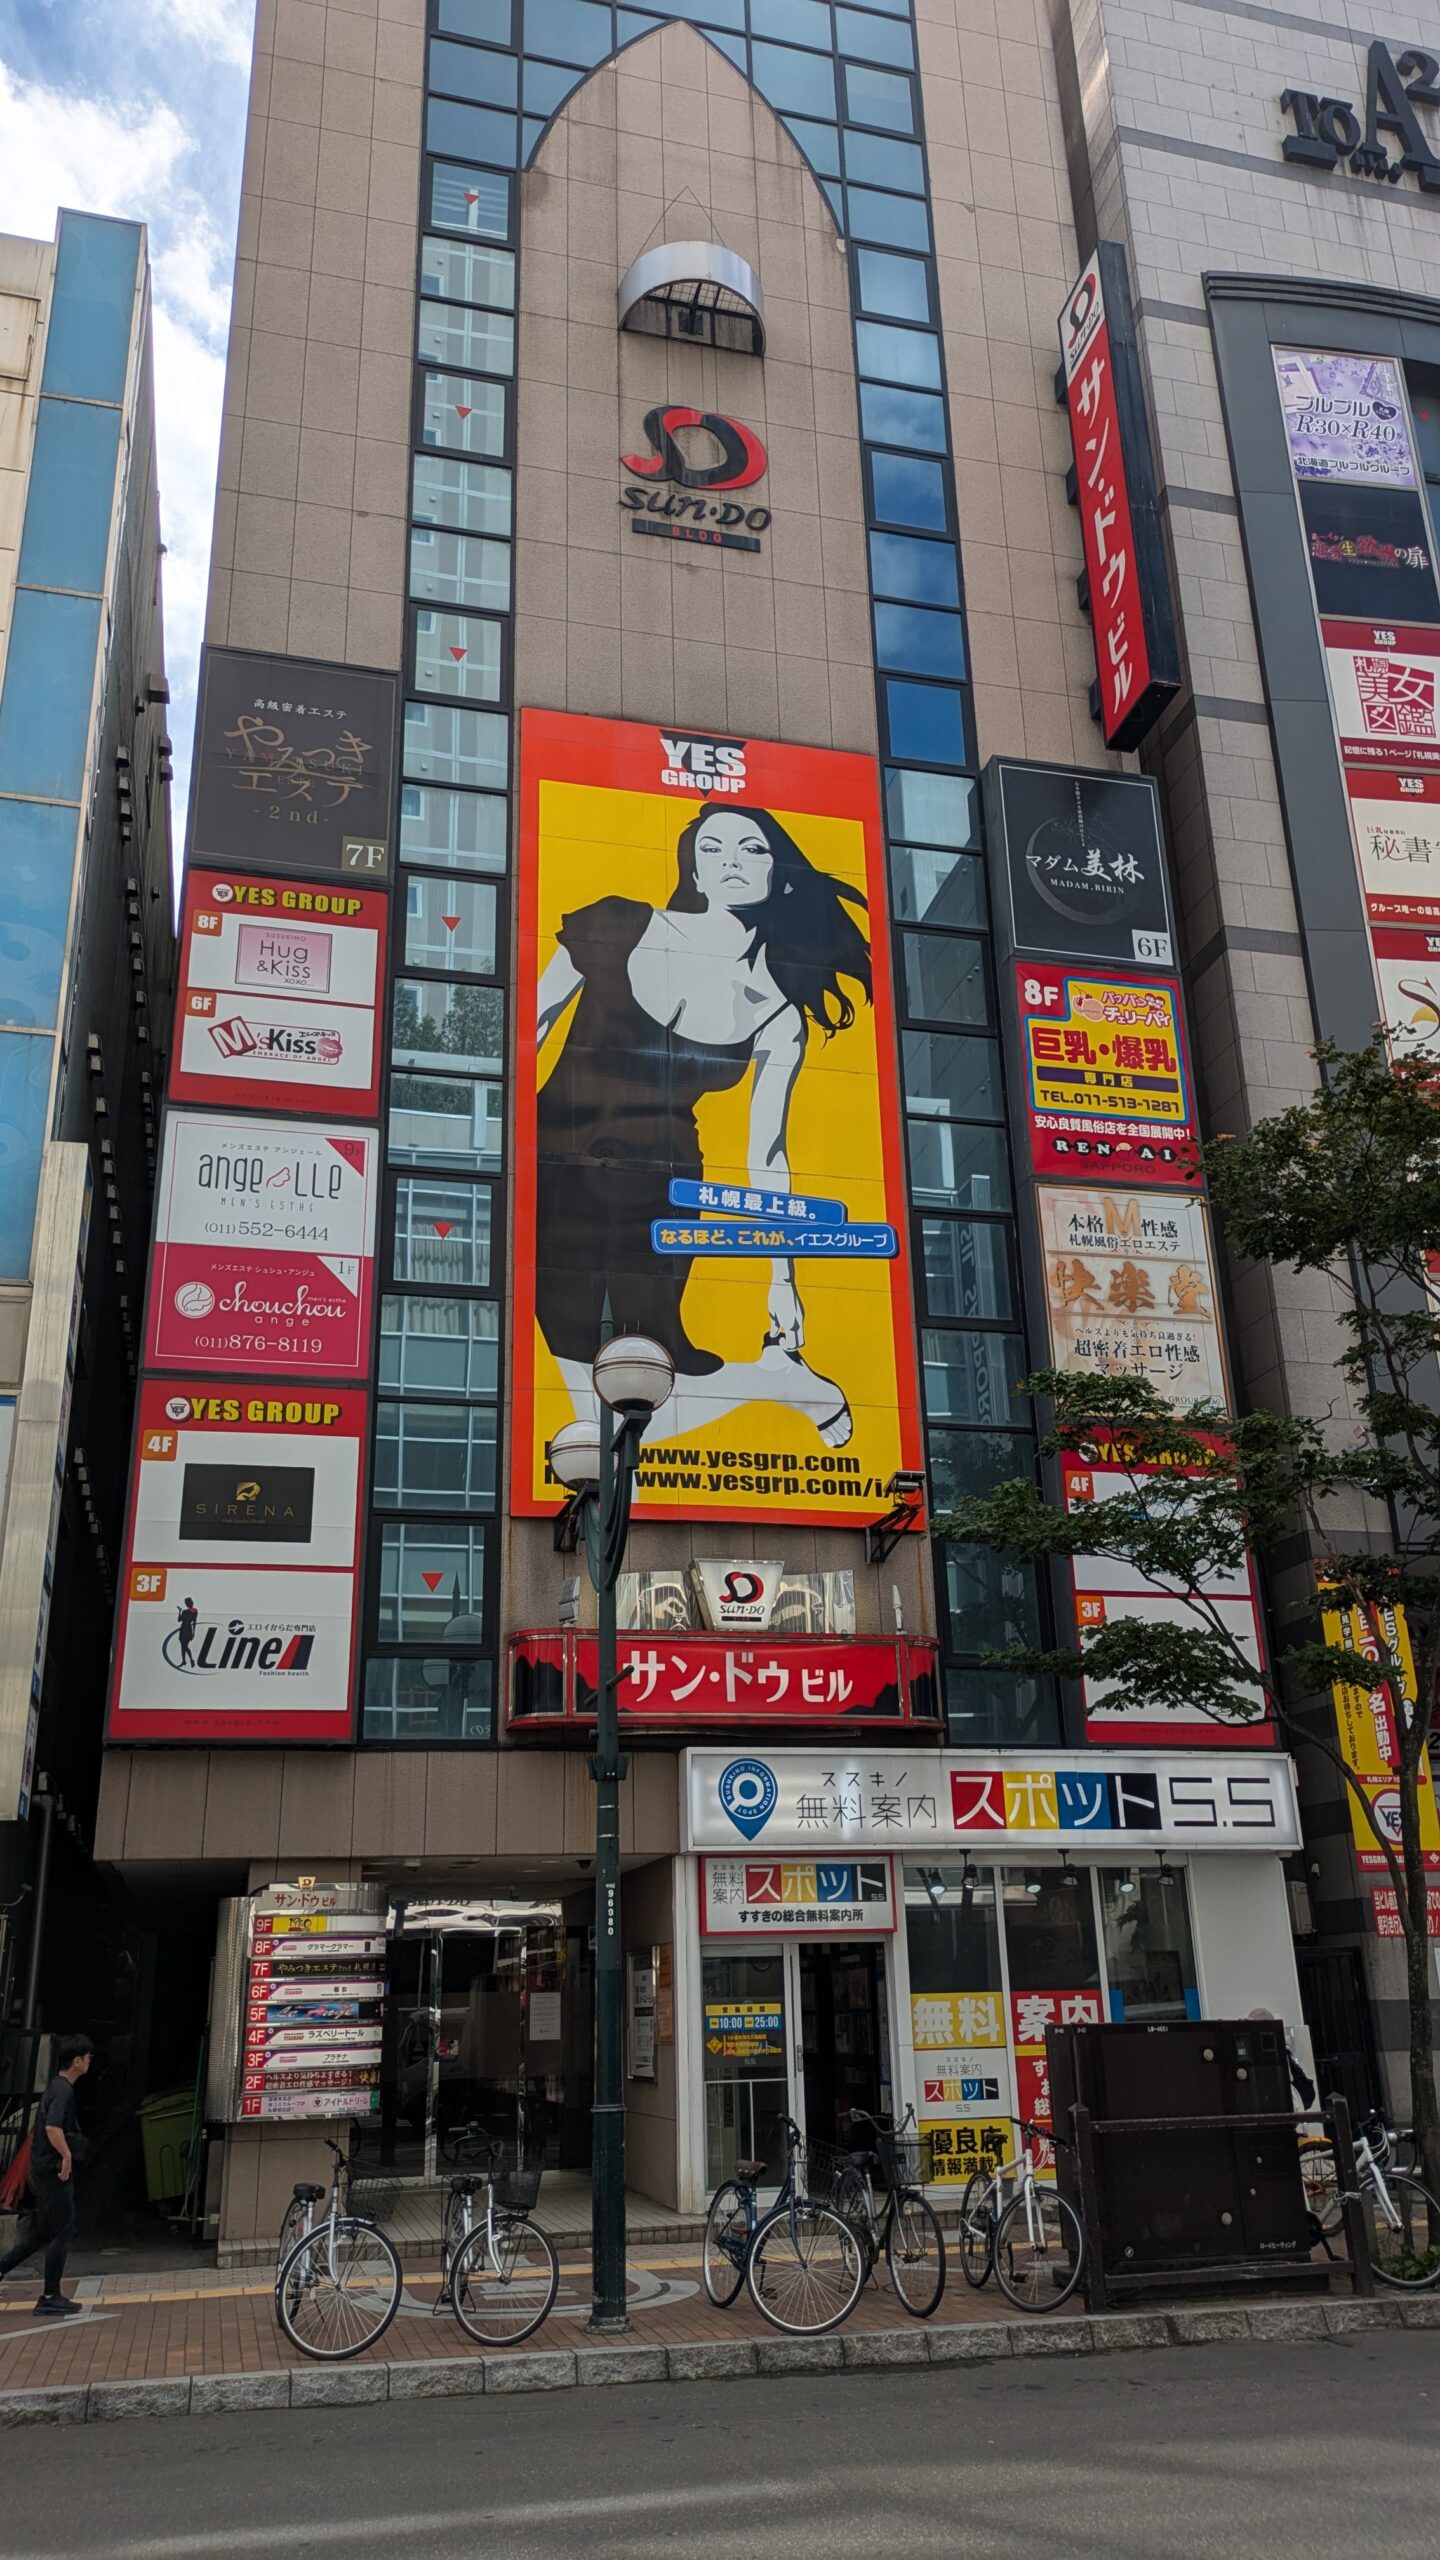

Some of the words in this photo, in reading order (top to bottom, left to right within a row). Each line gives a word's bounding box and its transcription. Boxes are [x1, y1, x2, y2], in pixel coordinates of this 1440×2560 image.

[1295, 395, 1371, 418] プルプル
[672, 525, 723, 544] BLDG
[1373, 629, 1396, 642] YES
[1374, 638, 1397, 647] GROUP
[1356, 666, 1435, 712] 美女
[253, 698, 348, 720] 高級密着エステ
[1362, 700, 1437, 738] 図鑑
[659, 737, 748, 778] YES
[231, 769, 364, 808] エステ
[660, 768, 747, 795] GROUP
[1398, 777, 1424, 789] YES
[1400, 786, 1424, 794] GROUP
[345, 843, 385, 868] 7F
[1025, 847, 1145, 884] マダム美林
[233, 885, 275, 906] YES
[281, 890, 362, 916] GROUP
[197, 914, 219, 930] 8F
[266, 932, 307, 941] SUSUKINO
[260, 939, 308, 963] Hug
[1137, 936, 1168, 958] 6F
[256, 959, 311, 979] &Kiss
[1024, 978, 1059, 1007] 8F
[191, 995, 213, 1011] 6F
[1103, 1006, 1171, 1027] チェリーパイ
[252, 1049, 289, 1058] EMBRACE
[1031, 1026, 1178, 1073] 巨乳・爆乳
[1084, 1071, 1133, 1088] 専門店
[1035, 1115, 1191, 1140] 安心良質風俗店を全国展開中!
[221, 1142, 270, 1152] メンズエステ
[274, 1146, 322, 1156] アンジェール
[1080, 1160, 1157, 1174] SAPPORO
[220, 1196, 260, 1209] MEN'S
[270, 1200, 314, 1212] ESTHE
[698, 1186, 817, 1220] 札幌最上級。
[660, 1229, 888, 1248] なるほど、これが、イエスグループ
[1069, 1234, 1181, 1254] 札幌風俗エロエステ
[210, 1263, 253, 1273] メンズエステ
[254, 1266, 316, 1277] シュシュ・アンジュ
[338, 1260, 356, 1275] 1F
[1051, 1258, 1212, 1320] 快楽堂
[219, 1281, 346, 1318] chouchou
[1074, 1338, 1201, 1363] 超密着エロ性感
[1094, 1361, 1183, 1380] マッサージ
[170, 1404, 186, 1414] YES
[191, 1398, 240, 1421] YES
[247, 1400, 341, 1425] GROUP
[148, 1436, 173, 1453] 4F
[1070, 1476, 1089, 1492] 4F
[195, 1503, 295, 1518] SIRENA
[136, 1575, 162, 1592] 3F
[1081, 1601, 1101, 1618] 3F
[247, 1623, 317, 1633] エロイからだ専門店
[623, 1650, 853, 1703] サン・ドウビル
[820, 1771, 907, 1787] ススキノ
[955, 1775, 1158, 1828] スポット
[795, 1793, 938, 1829] 無料案内
[1385, 1811, 1403, 1828] YE
[711, 1871, 745, 1889] 無料
[747, 1864, 884, 1902] スポット
[274, 1893, 337, 1908] サン・ドウビル
[711, 1889, 745, 1905] 案内
[738, 1909, 864, 1923] すすきの総合無料案内所
[256, 1918, 272, 1932] 9F
[255, 1940, 271, 1953] 8F
[253, 1963, 269, 1976] 7F
[251, 1985, 267, 1998] 6F
[250, 2007, 266, 2021] 5F
[720, 2017, 743, 2029] 10:00
[755, 2016, 779, 2028] 25:00
[914, 1996, 1000, 2045] 無料
[1016, 1994, 1099, 2042] 案内
[248, 2030, 265, 2043] 4F
[308, 2030, 365, 2038] ラズベリードール
[247, 2053, 264, 2066] 3F
[936, 2063, 983, 2076] 無料案内
[245, 2076, 262, 2089] 2F
[926, 2079, 999, 2101] スポット
[245, 2099, 261, 2113] 1F
[930, 2125, 1004, 2156] 優良店
